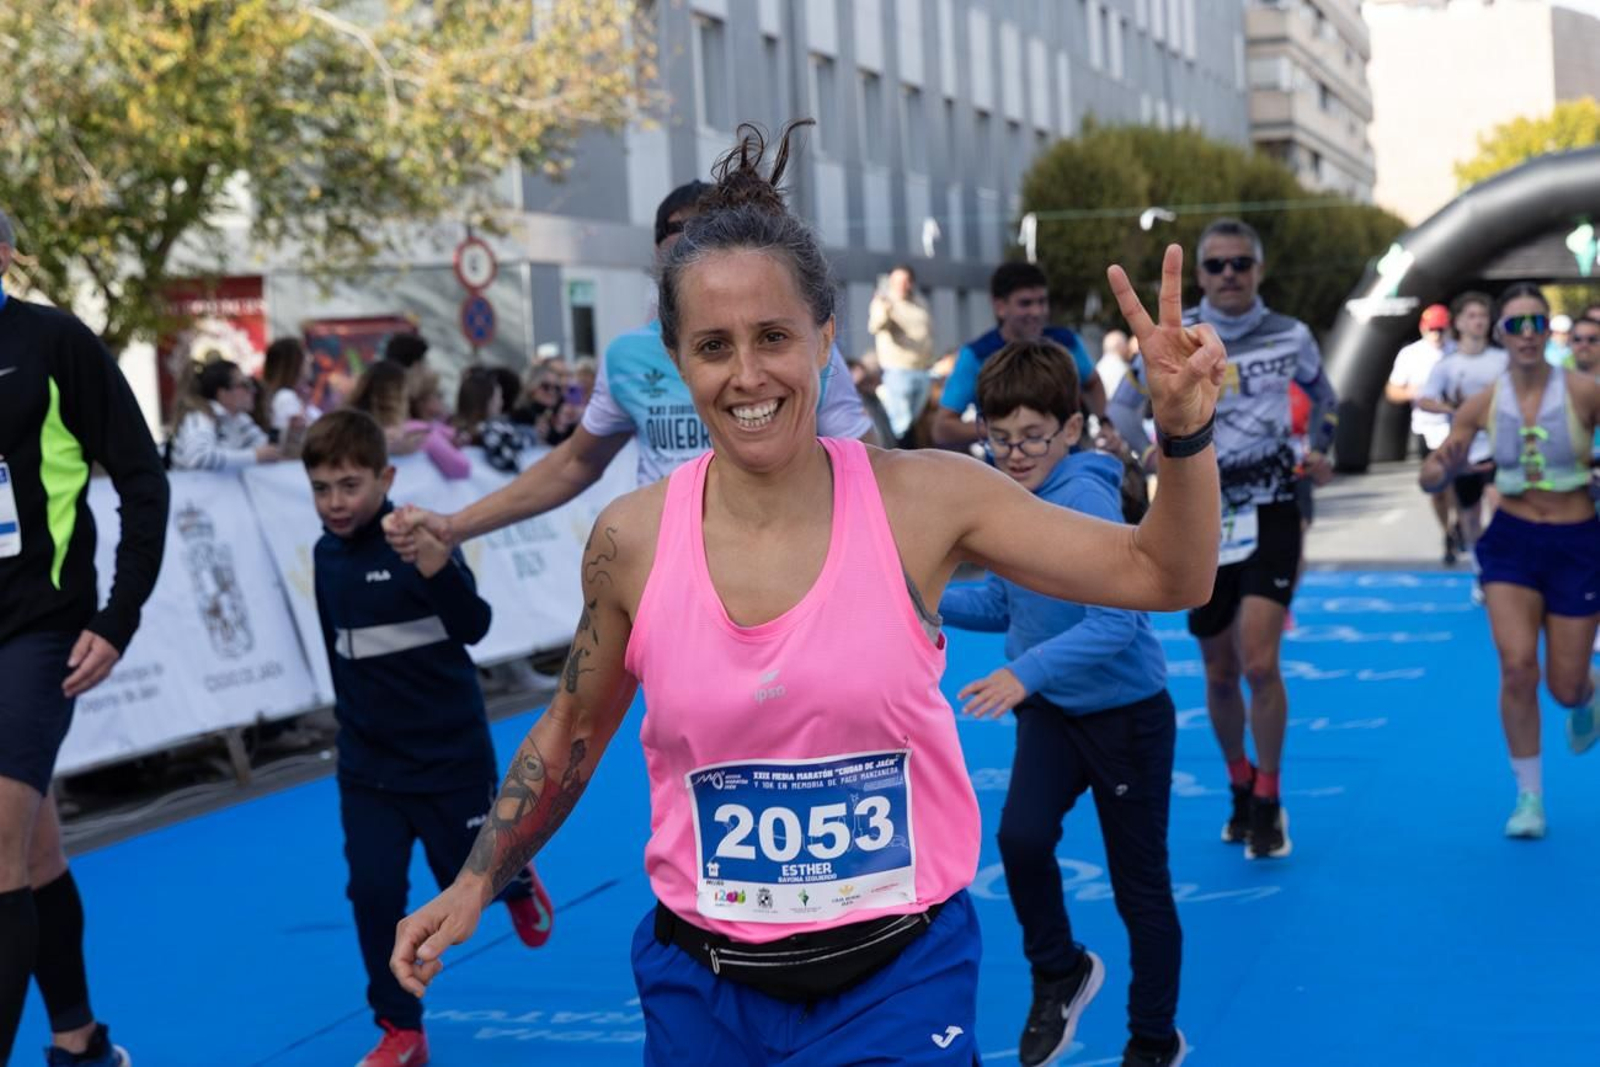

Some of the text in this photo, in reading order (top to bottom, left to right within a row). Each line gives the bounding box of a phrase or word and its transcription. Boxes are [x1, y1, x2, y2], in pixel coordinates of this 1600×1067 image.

[753, 771, 770, 780] XXIX
[772, 771, 795, 780] MEDIA
[797, 768, 833, 780] MARATÓN
[864, 760, 875, 770] DE
[777, 782, 788, 790] EN
[791, 781, 824, 790] MEMORIA
[827, 779, 837, 787] DE
[714, 795, 895, 862] 2053
[782, 862, 832, 876] ESTHER
